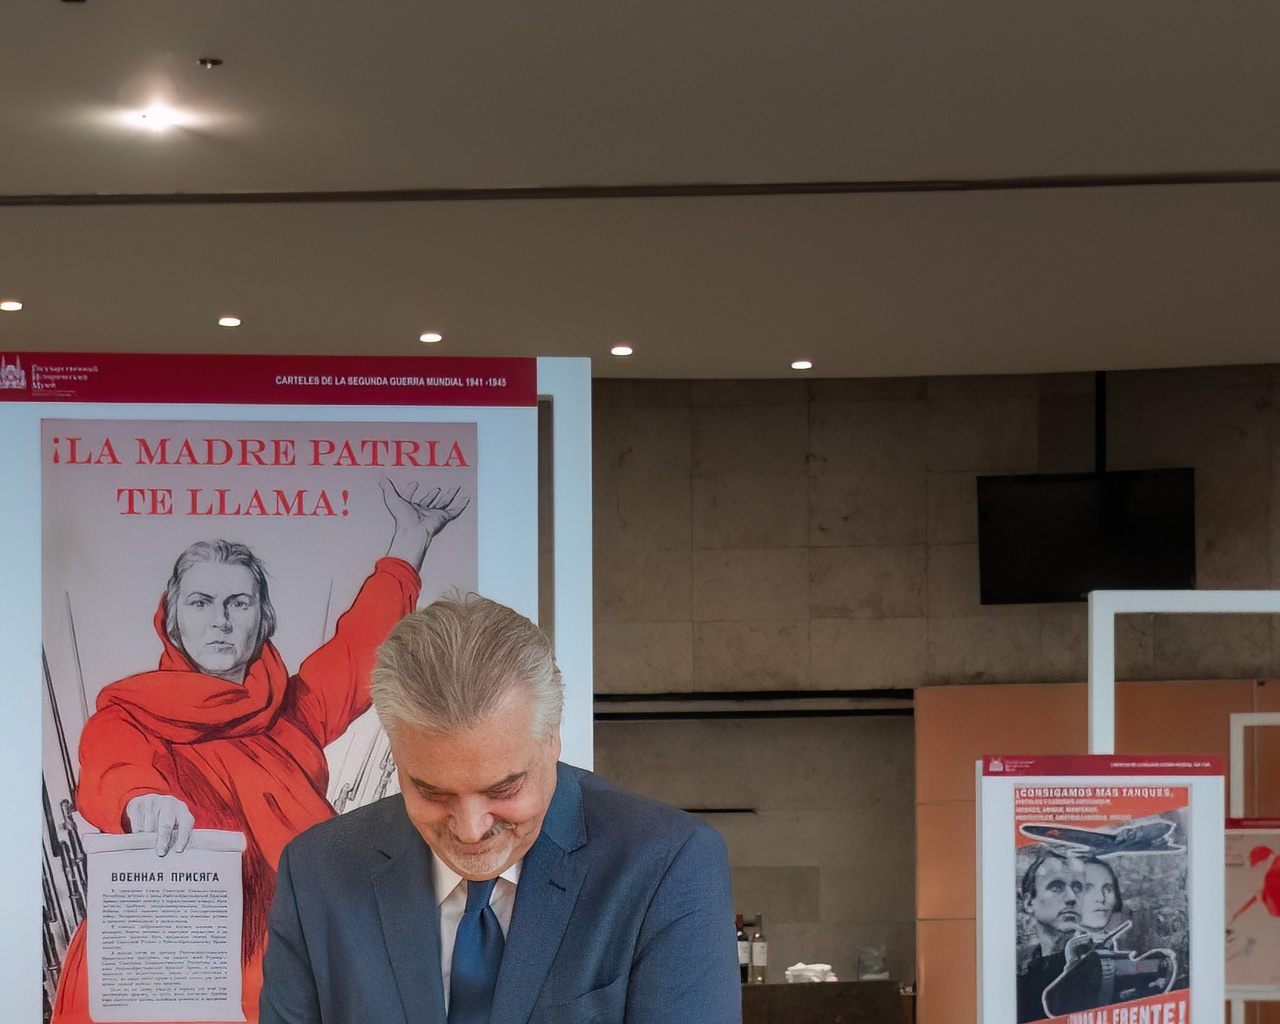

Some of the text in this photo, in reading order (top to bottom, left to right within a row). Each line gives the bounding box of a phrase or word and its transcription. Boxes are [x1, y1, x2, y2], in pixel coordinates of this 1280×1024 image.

[275, 376, 320, 386] CARTELES
[321, 376, 333, 386] DE
[334, 376, 347, 386] LA
[347, 376, 389, 386] SEGUNDA
[389, 377, 425, 386] GUERRA
[426, 377, 464, 387] MUNDIAL
[465, 378, 484, 387] 1941
[52, 436, 471, 468] ¡LA MADRE PATRIA
[117, 488, 351, 518] TE LLAMA!
[111, 872, 220, 882] ВОЕННАЯ ПРИСЯГА
